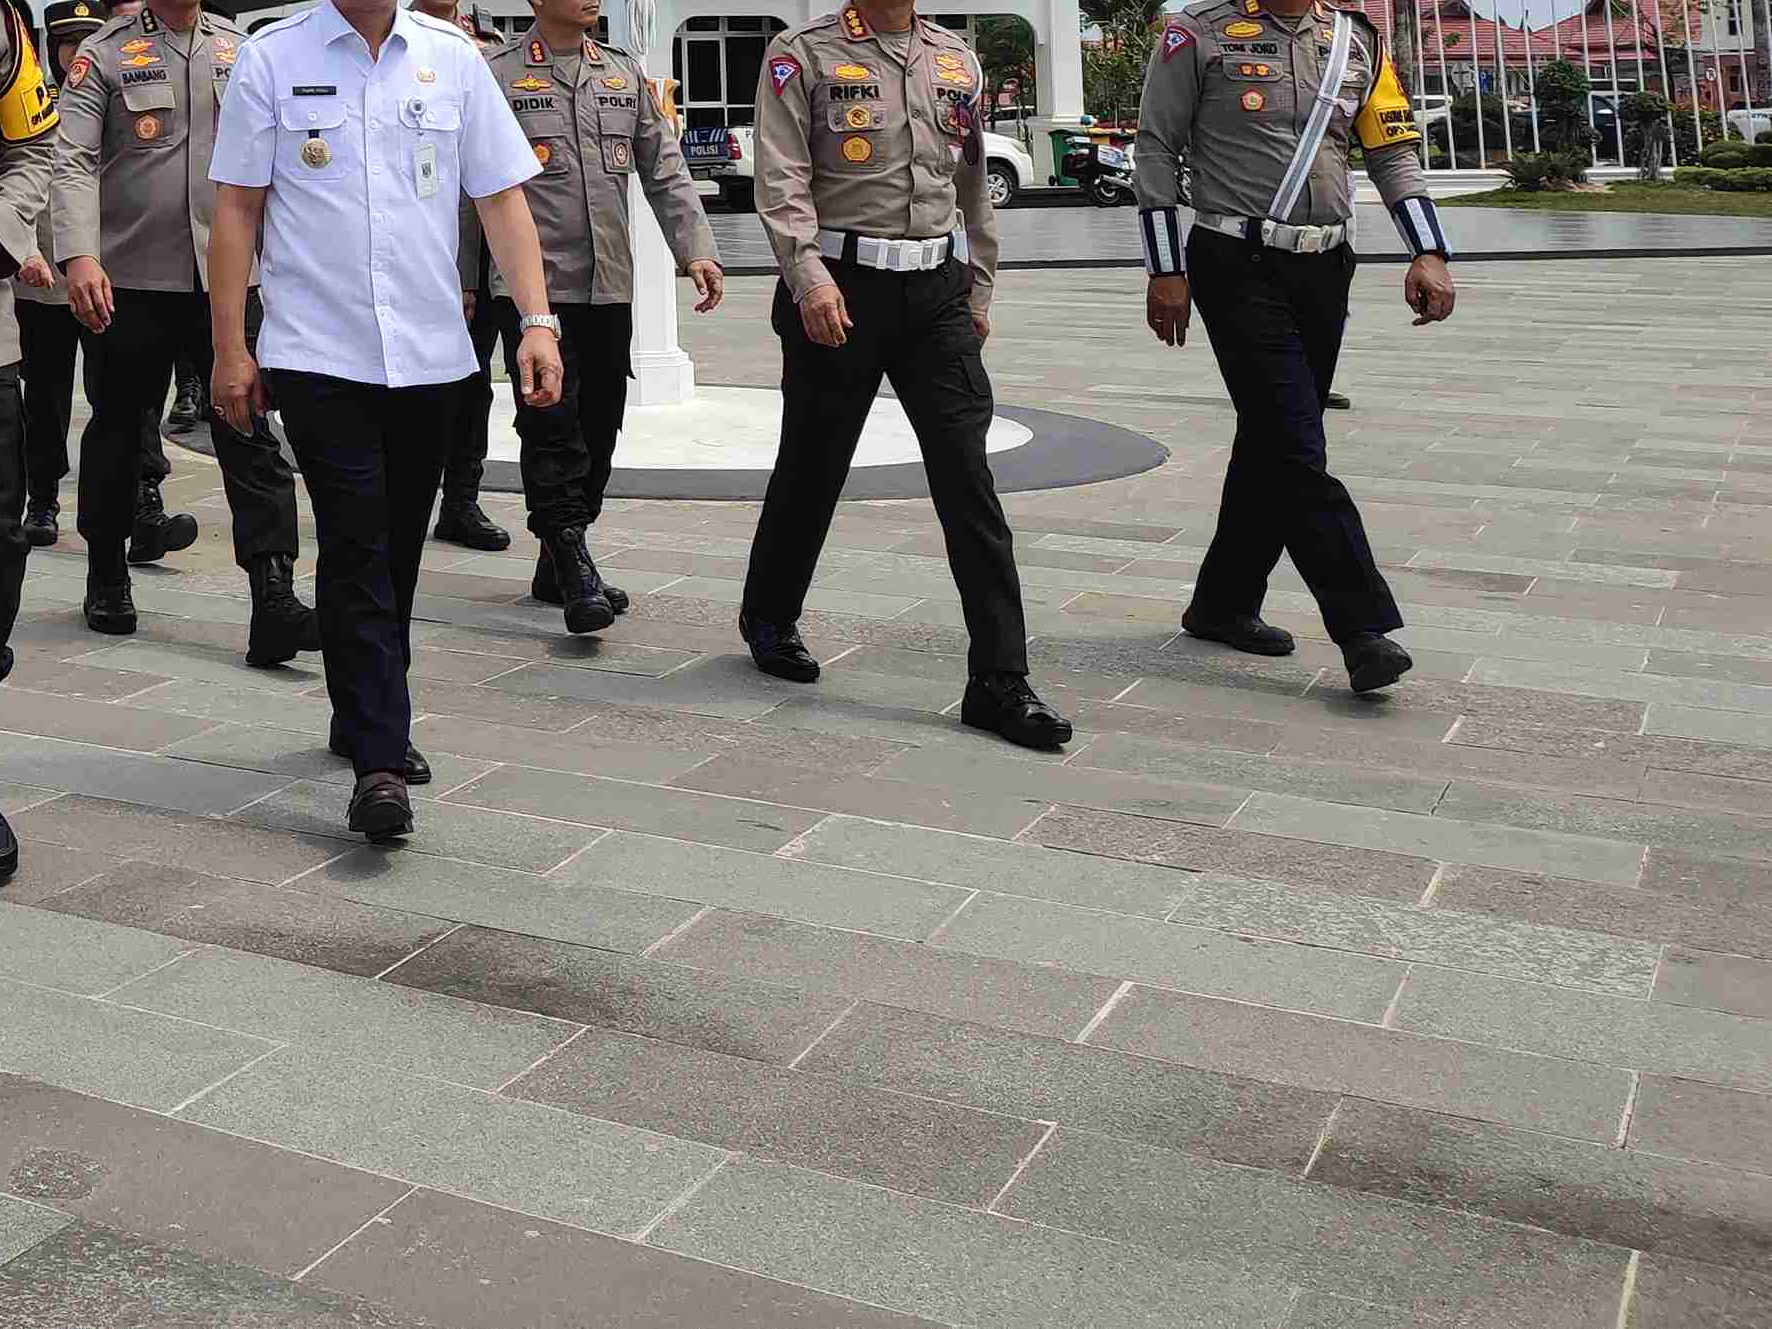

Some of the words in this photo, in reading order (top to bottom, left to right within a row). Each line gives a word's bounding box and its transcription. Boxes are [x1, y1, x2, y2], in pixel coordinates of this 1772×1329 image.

[122, 69, 167, 85] BAMBANG
[830, 85, 880, 101] RIFKI
[513, 97, 555, 111] DIDIK
[598, 96, 637, 109] POLRI
[691, 144, 719, 156] POLISI
